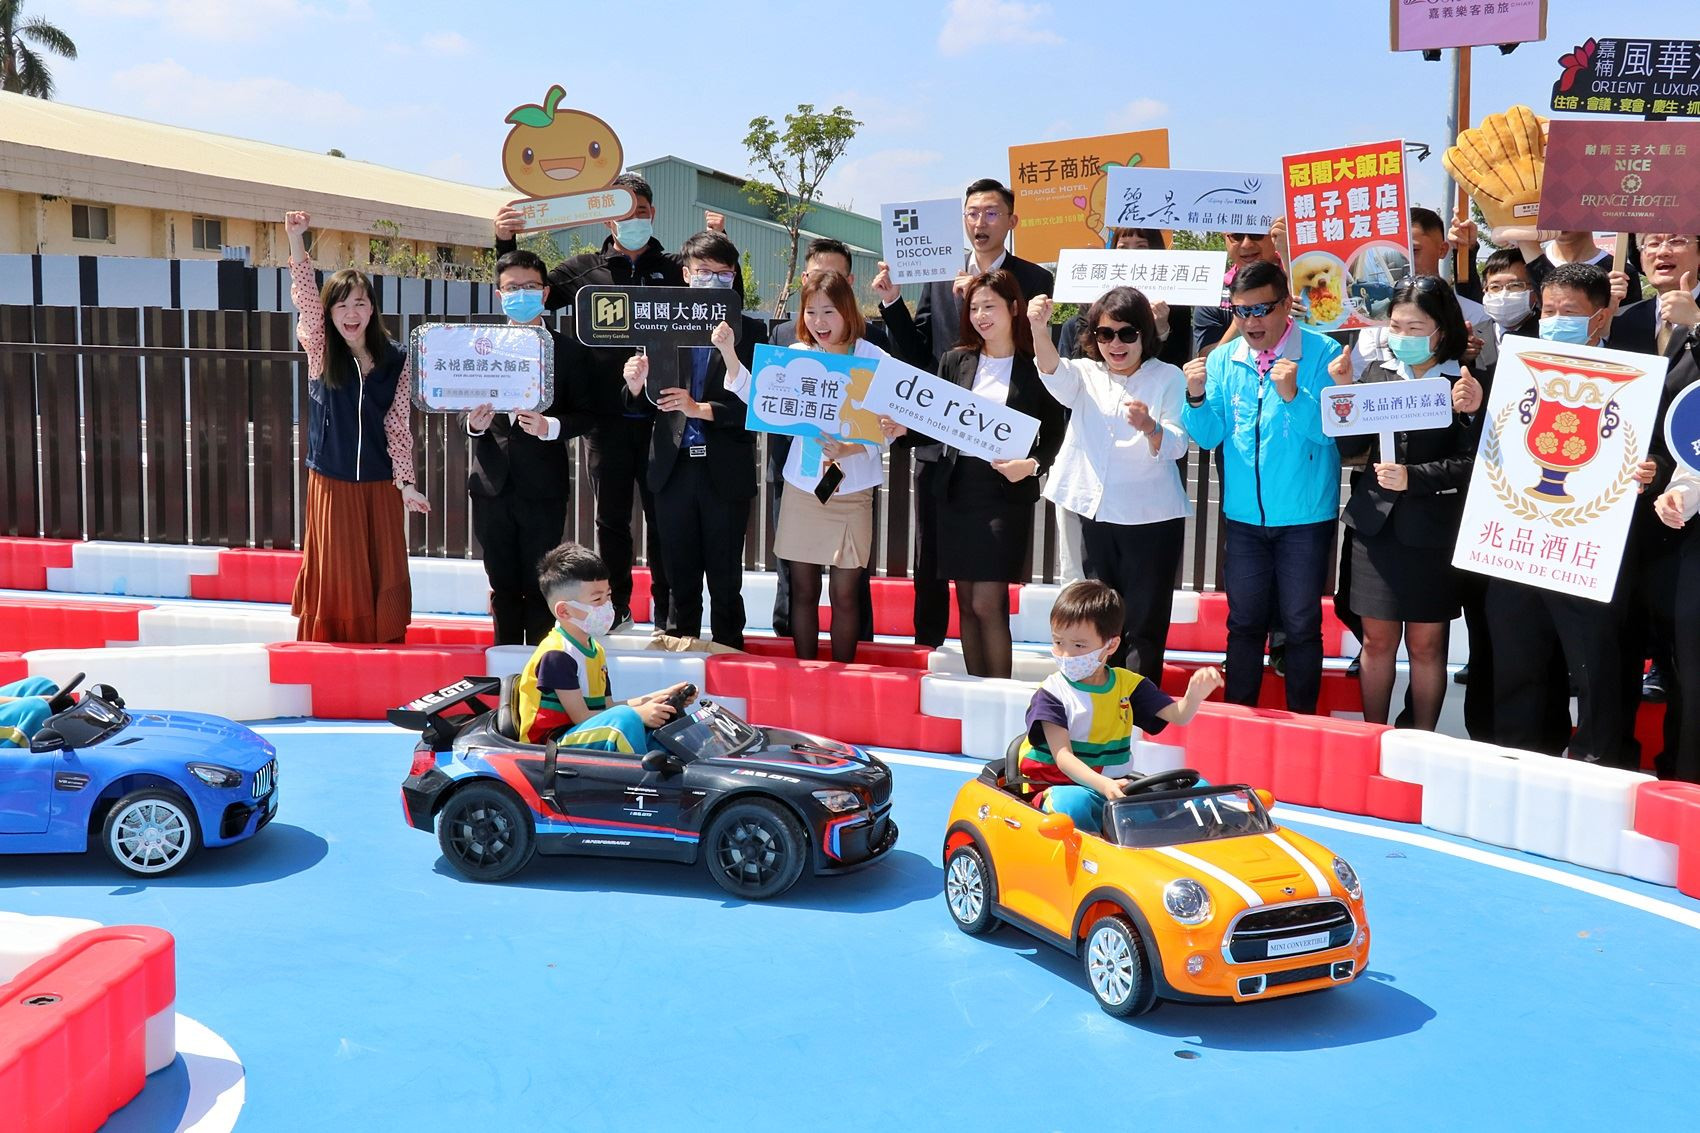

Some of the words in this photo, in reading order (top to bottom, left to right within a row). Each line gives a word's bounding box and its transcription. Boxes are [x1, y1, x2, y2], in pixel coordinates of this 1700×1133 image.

[1428, 2, 1509, 20] 嘉義樂客商旅
[1595, 41, 1616, 78] 嘉楠
[1591, 80, 1646, 94] ORIENT
[1584, 144, 1687, 156] 耐斯王子大飯店
[1018, 155, 1100, 184] 桔子商旅
[1614, 159, 1652, 171] NICE
[1020, 188, 1056, 197] ORANGE
[1059, 184, 1088, 193] HOTEL
[522, 203, 549, 220] 桔子
[588, 194, 616, 211] 商旅
[1293, 184, 1398, 219] 親子飯店
[1580, 193, 1628, 208] PRINCE
[1631, 194, 1680, 207] HOTEL
[1295, 211, 1400, 245] 寵物友善
[895, 236, 932, 246] HOTEL
[896, 246, 952, 258] DISCOVER
[897, 260, 922, 268] CHIAYI
[1071, 263, 1211, 283] 德爾芙快捷酒店
[634, 302, 727, 320] 國園大飯店
[633, 322, 668, 332] Country
[672, 323, 701, 331] Garden
[761, 395, 837, 421] 花園酒店
[895, 375, 934, 408] de
[943, 400, 1012, 442] rêve
[1362, 392, 1447, 412] 兆品酒店嘉義
[888, 401, 925, 422] express
[926, 416, 950, 433] hotel
[1478, 521, 1600, 570] 兆品酒店
[1469, 551, 1525, 572] MAISON
[1528, 564, 1547, 577] DE
[1551, 569, 1598, 589] CHINE
[438, 679, 474, 698] GT3
[714, 714, 742, 737] 04
[635, 795, 644, 810] 1
[1183, 797, 1223, 827] 11
[1270, 943, 1286, 951] MINI
[1286, 936, 1328, 949] CONVERTIBLE
